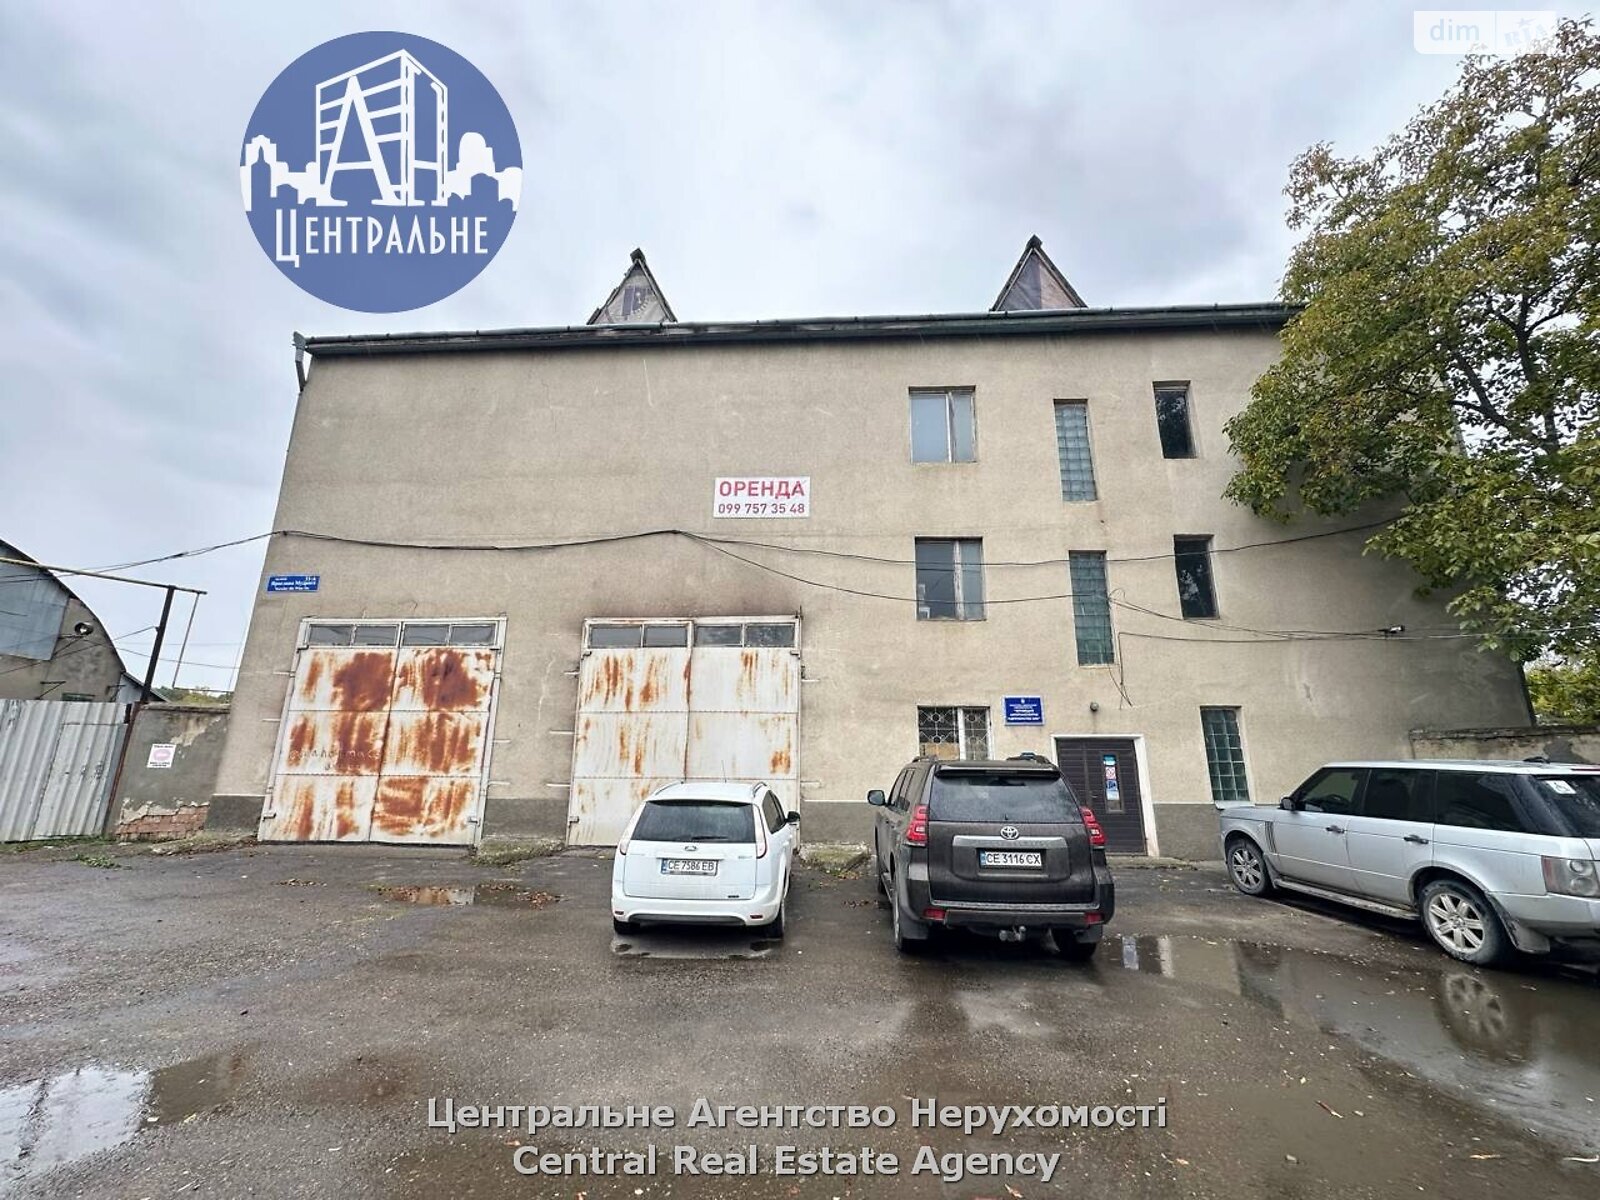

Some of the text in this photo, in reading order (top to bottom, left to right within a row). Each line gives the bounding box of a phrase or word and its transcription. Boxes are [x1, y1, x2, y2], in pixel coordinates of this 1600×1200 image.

[719, 480, 805, 499] ОРЕНДА
[718, 503, 805, 514] 099 757 35 48
[1002, 854, 1025, 865] 3116
